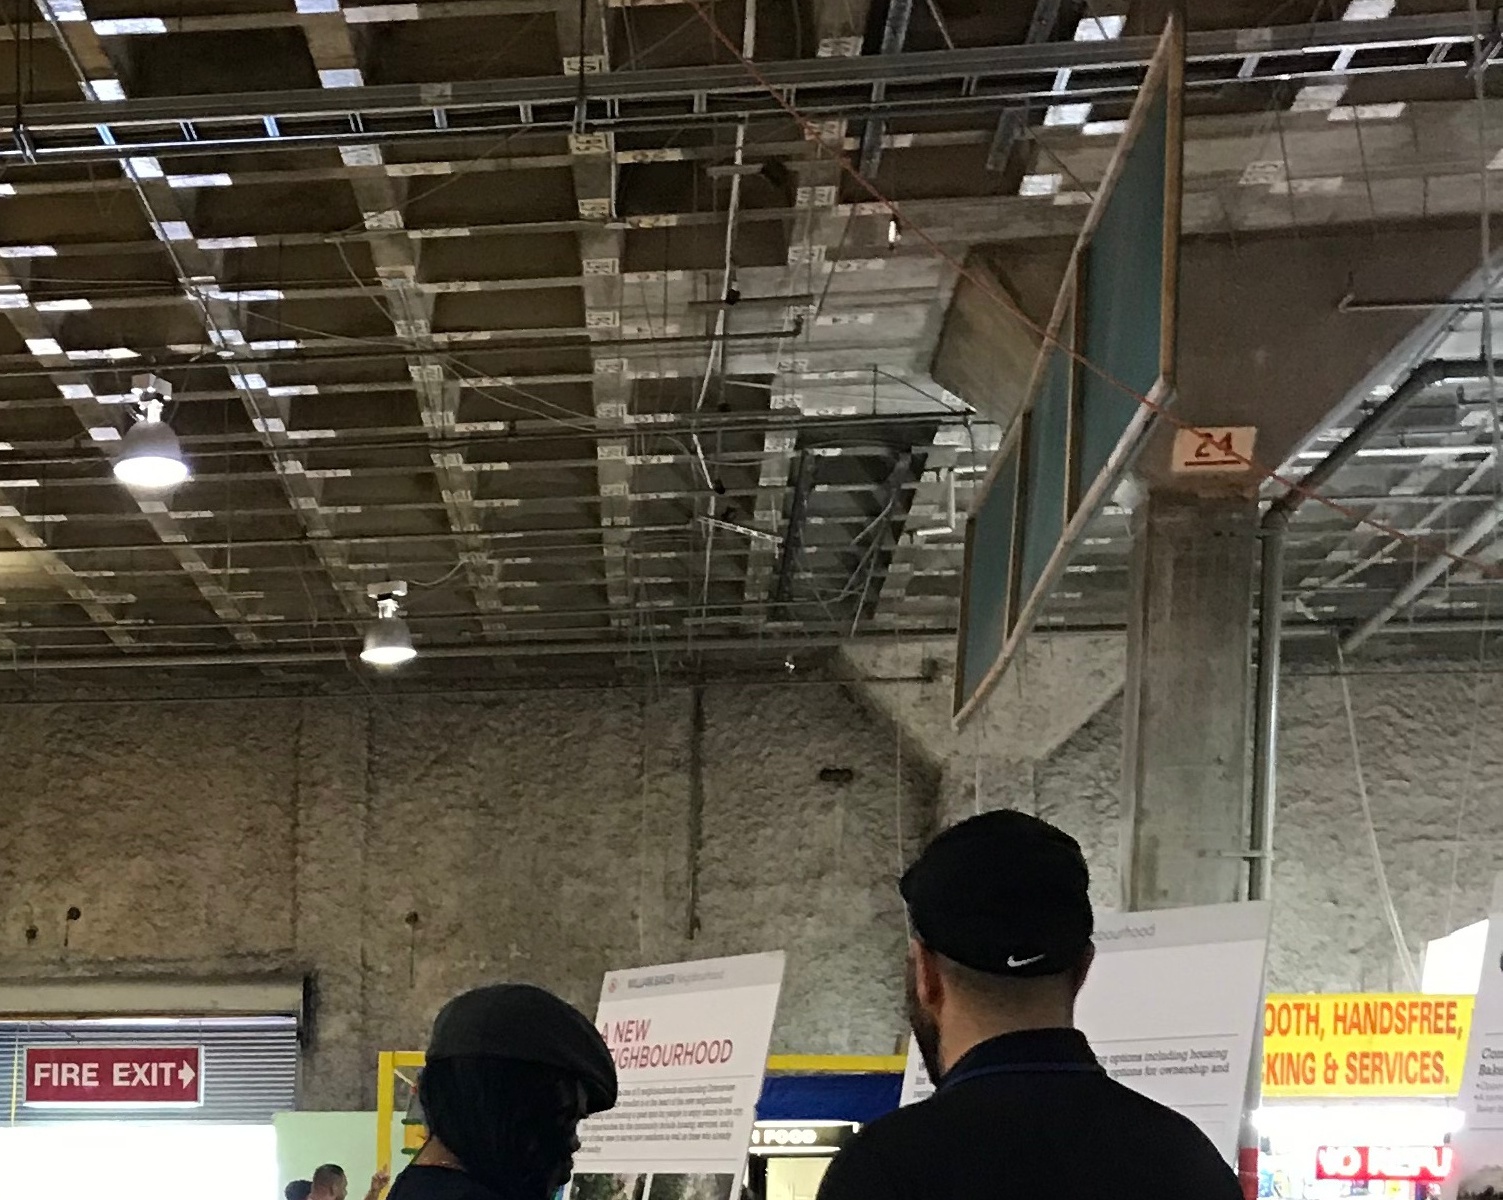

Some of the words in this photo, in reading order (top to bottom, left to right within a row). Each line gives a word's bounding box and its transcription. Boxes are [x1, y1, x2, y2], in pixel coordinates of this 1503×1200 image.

[613, 1019, 652, 1043] NEW
[1333, 1001, 1463, 1041] HANDSFREE,
[1144, 1050, 1188, 1062] including
[1190, 1049, 1229, 1061] housing
[1262, 1051, 1316, 1085] KING
[1323, 1051, 1339, 1085] &
[1345, 1050, 1450, 1085] SERVICES.
[34, 1062, 99, 1087] FIRE
[112, 1062, 177, 1087] EXIT
[1144, 1066, 1157, 1076] for
[1159, 1064, 1209, 1076] ownership
[1211, 1062, 1230, 1073] and
[763, 1129, 818, 1145] FOOD
